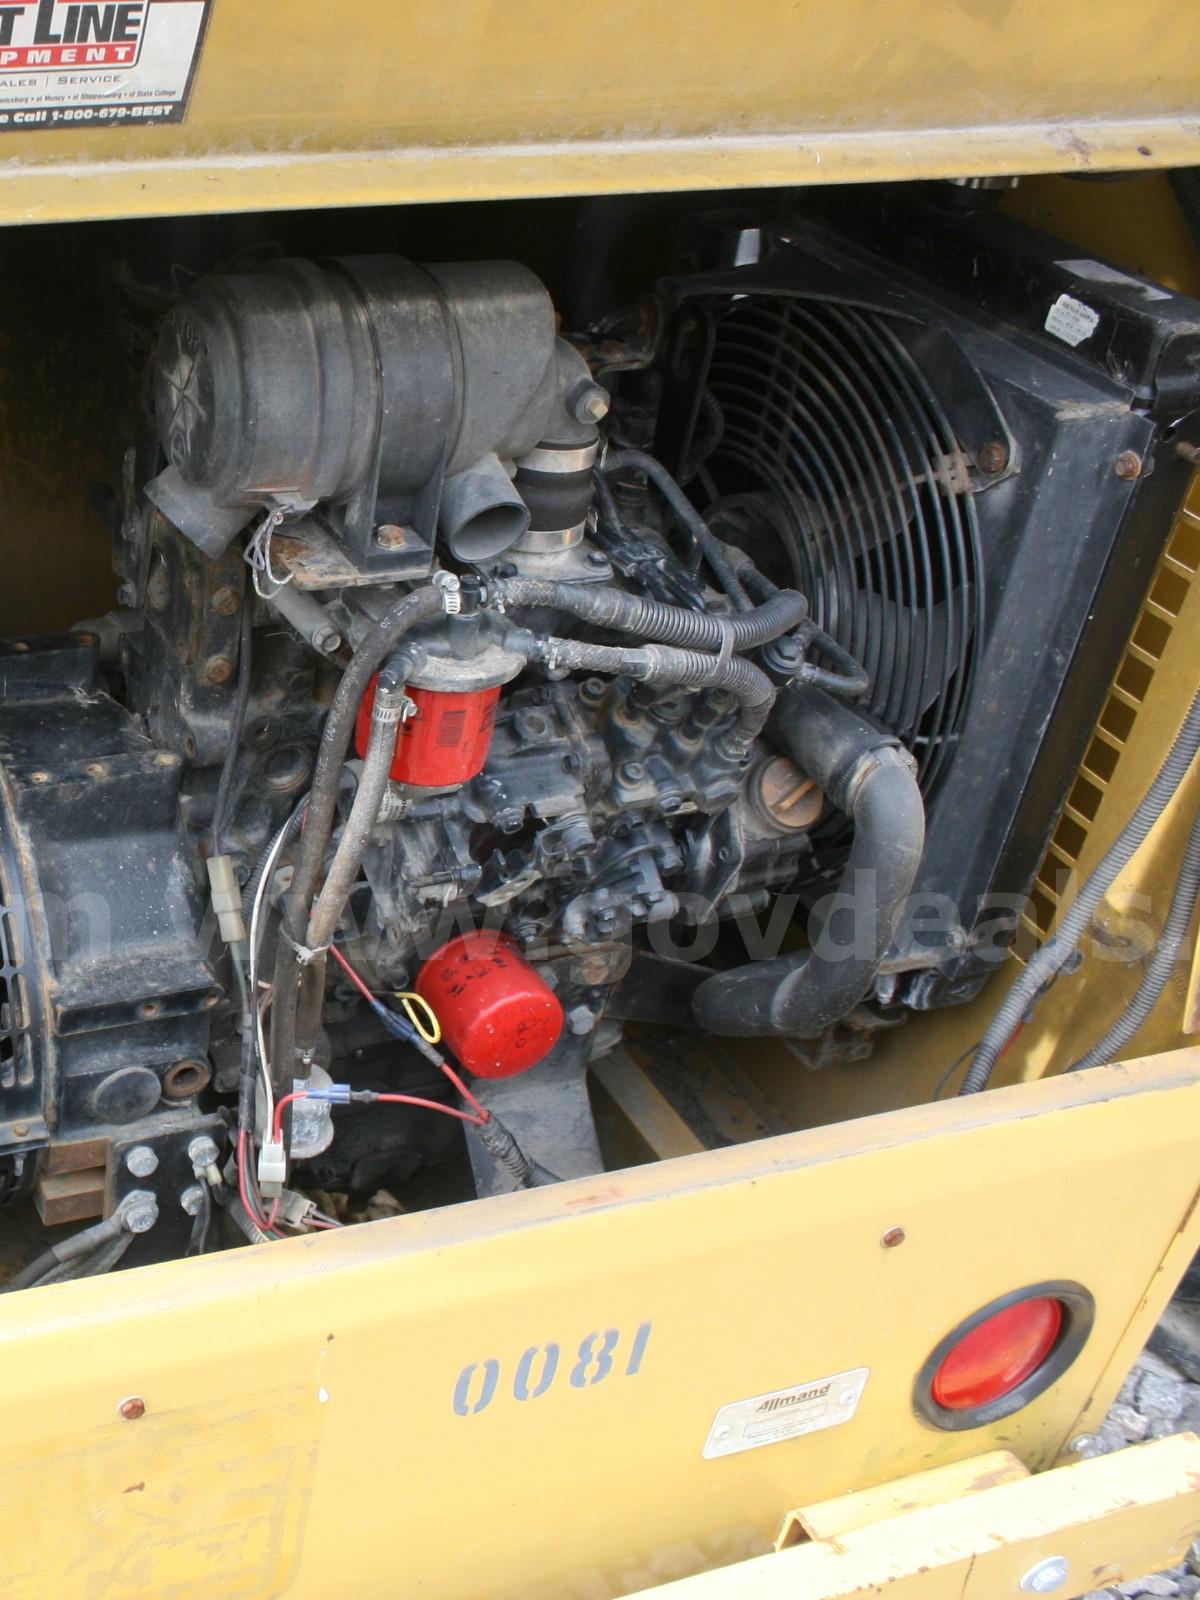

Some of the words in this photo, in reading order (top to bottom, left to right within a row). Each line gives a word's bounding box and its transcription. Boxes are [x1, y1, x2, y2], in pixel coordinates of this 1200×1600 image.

[58, 74, 121, 85] SERVICE
[13, 111, 47, 123] Call
[52, 105, 173, 121] 1-800-679-BEST
[453, 1319, 652, 1416] 0081
[755, 1383, 832, 1413] Allmand
